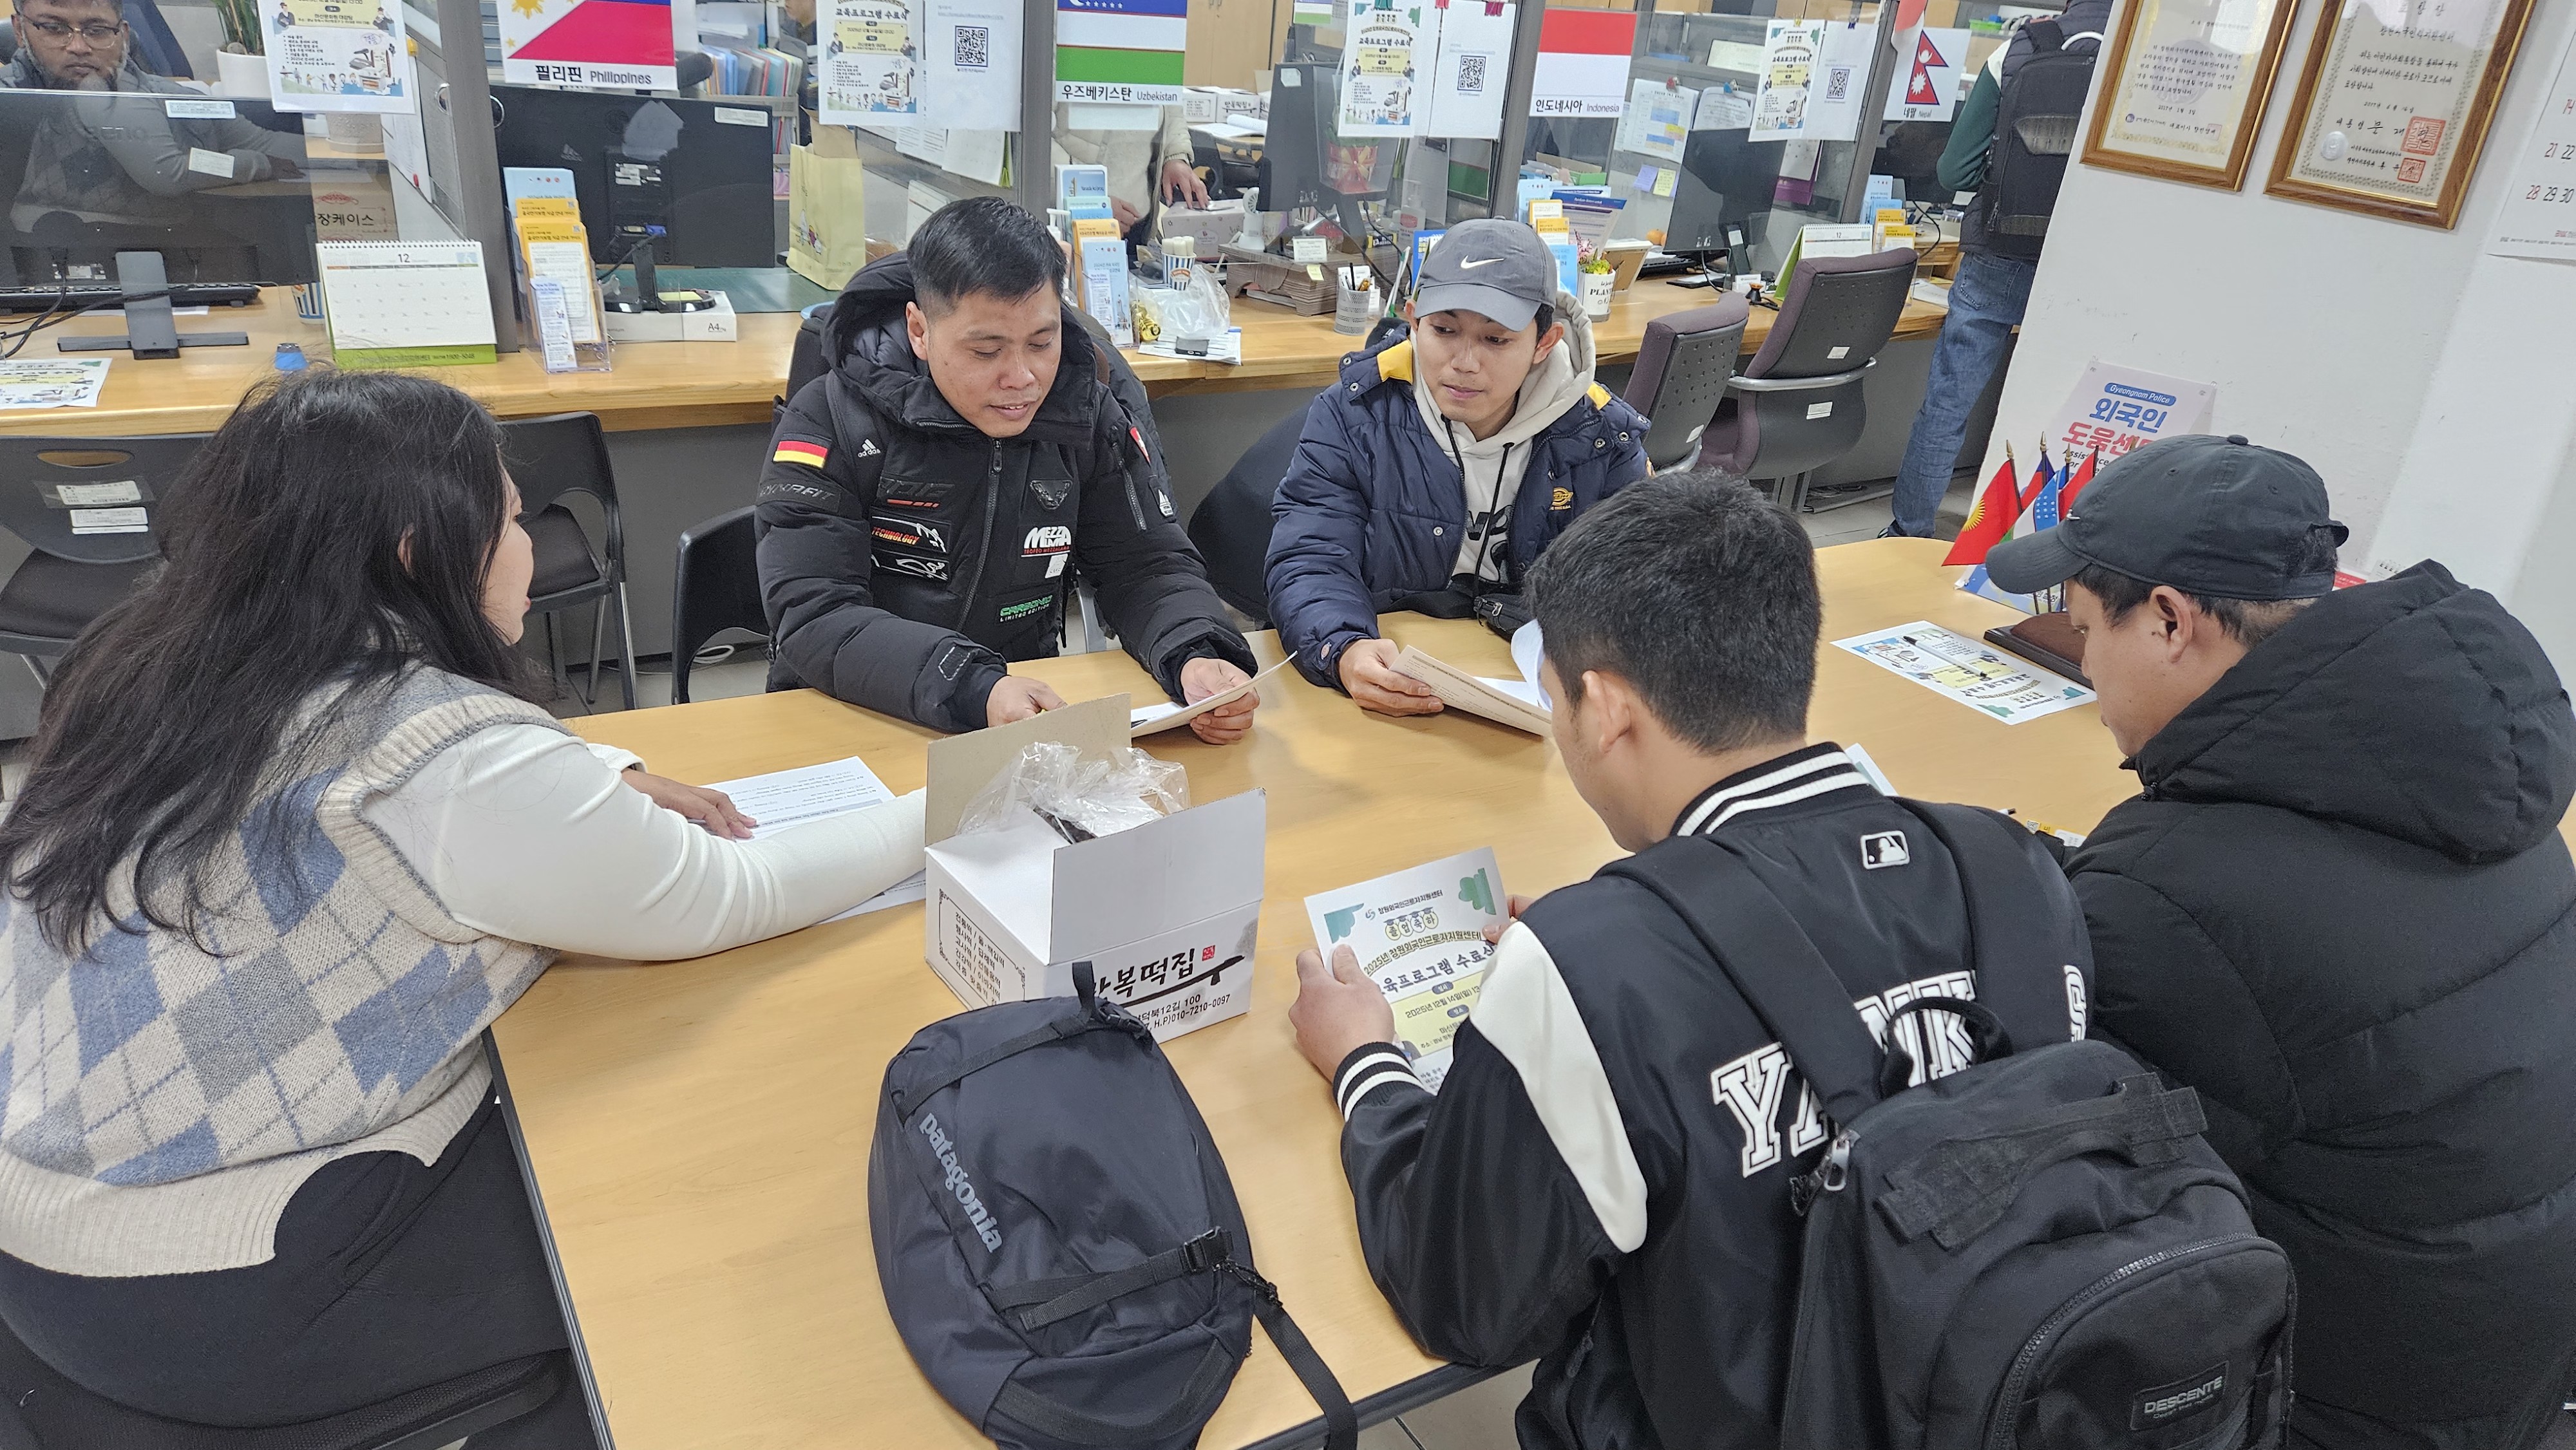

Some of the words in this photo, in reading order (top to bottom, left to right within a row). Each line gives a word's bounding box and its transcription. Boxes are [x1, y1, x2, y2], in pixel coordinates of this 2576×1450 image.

[836, 8, 882, 19] 교육프로그램
[1359, 37, 1392, 46] 교육프로그램
[535, 65, 582, 82] 필리핀
[590, 70, 652, 84] Philippines
[1062, 85, 1132, 101] 우즈베키스탄
[1137, 91, 1177, 101] Uzbekistan
[1536, 99, 1582, 113] 인도네시아
[1586, 103, 1620, 112] Indonesia
[1904, 107, 1917, 118] 네팔
[2544, 142, 2559, 158] 21
[2561, 144, 2576, 160] 22
[2526, 185, 2541, 200] 28
[2543, 187, 2558, 202] 29
[2559, 188, 2575, 203] 30
[315, 213, 374, 226] 장케이스
[398, 254, 410, 263] 12
[708, 323, 719, 331] A4
[2110, 384, 2148, 399] Gyeongnam
[2148, 393, 2170, 404] Police
[2089, 398, 2168, 433] 외국인
[2062, 422, 2154, 456] 도움센
[871, 527, 920, 545] TECHNOLOGY
[1043, 545, 1070, 554] MEZZALAMA
[1000, 612, 1026, 622] LIMITED
[1378, 889, 1443, 915] 창원외국인근로자지원센터
[955, 912, 972, 935] 전통떡
[955, 924, 972, 946] 행사떡
[955, 936, 972, 959] 고사떡
[1363, 952, 1390, 975] 2025년
[1389, 931, 1481, 959] 창원외국인근로자지원센터
[1382, 958, 1455, 995] 육프로그램
[1184, 994, 1201, 1006] 100
[1434, 996, 1448, 1008] 12월
[1154, 994, 1231, 1027] H.P)010-7210-0097
[918, 1113, 1003, 1254] patagonia
[2144, 1375, 2223, 1414] DESCENTE
